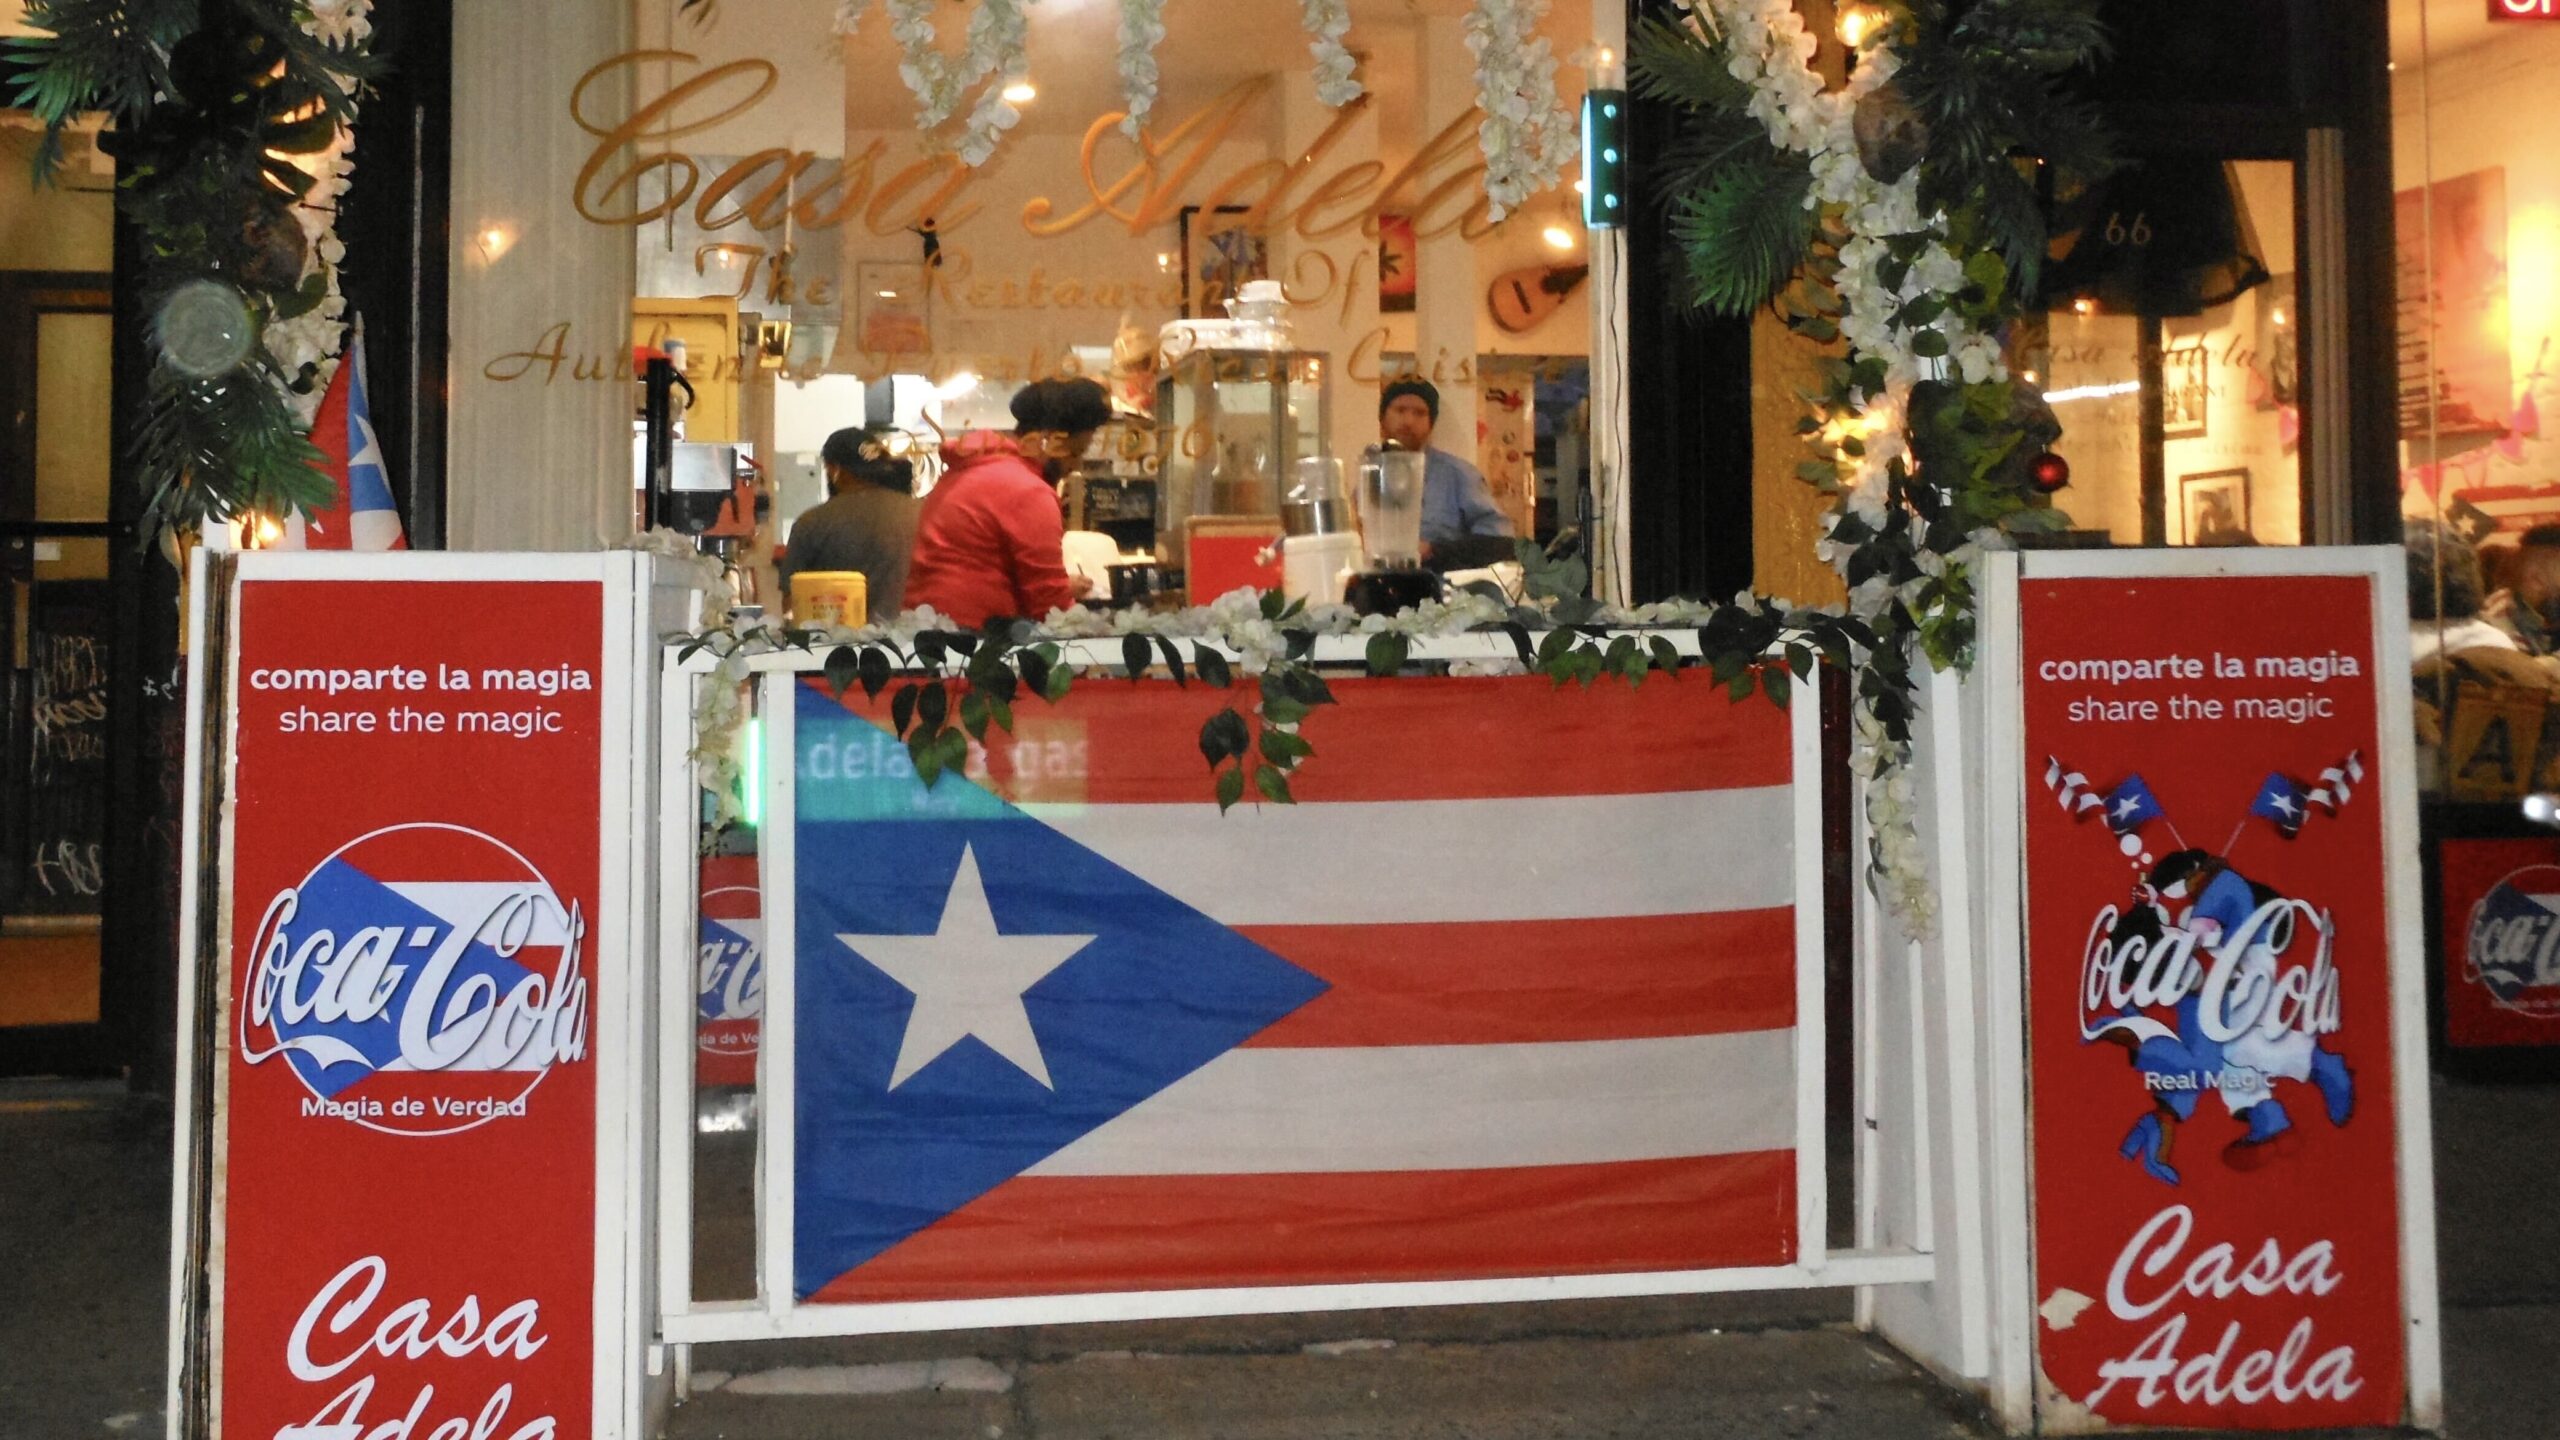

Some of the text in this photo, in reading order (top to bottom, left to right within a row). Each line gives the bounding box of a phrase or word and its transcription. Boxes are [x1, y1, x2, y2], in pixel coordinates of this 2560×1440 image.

[570, 50, 1515, 240] Casa Adela
[2105, 210, 2152, 246] 66
[695, 243, 1372, 330] The Restauran Of
[484, 321, 826, 388] Authenc
[250, 662, 592, 695] comparte la magia
[2040, 650, 2360, 685] comparte la magia
[279, 705, 563, 739] share the magic
[2068, 692, 2333, 724] share the magic
[240, 886, 588, 1071] Coca-Cola
[2079, 898, 2340, 1043] Coca-Cola
[720, 1032, 738, 1045] de
[2144, 1068, 2278, 1095] Real Magic
[301, 1096, 527, 1121] Magia de Verdad
[2106, 1204, 2343, 1321] Casa
[286, 1255, 549, 1383] Casa
[2084, 1311, 2365, 1412] Adela
